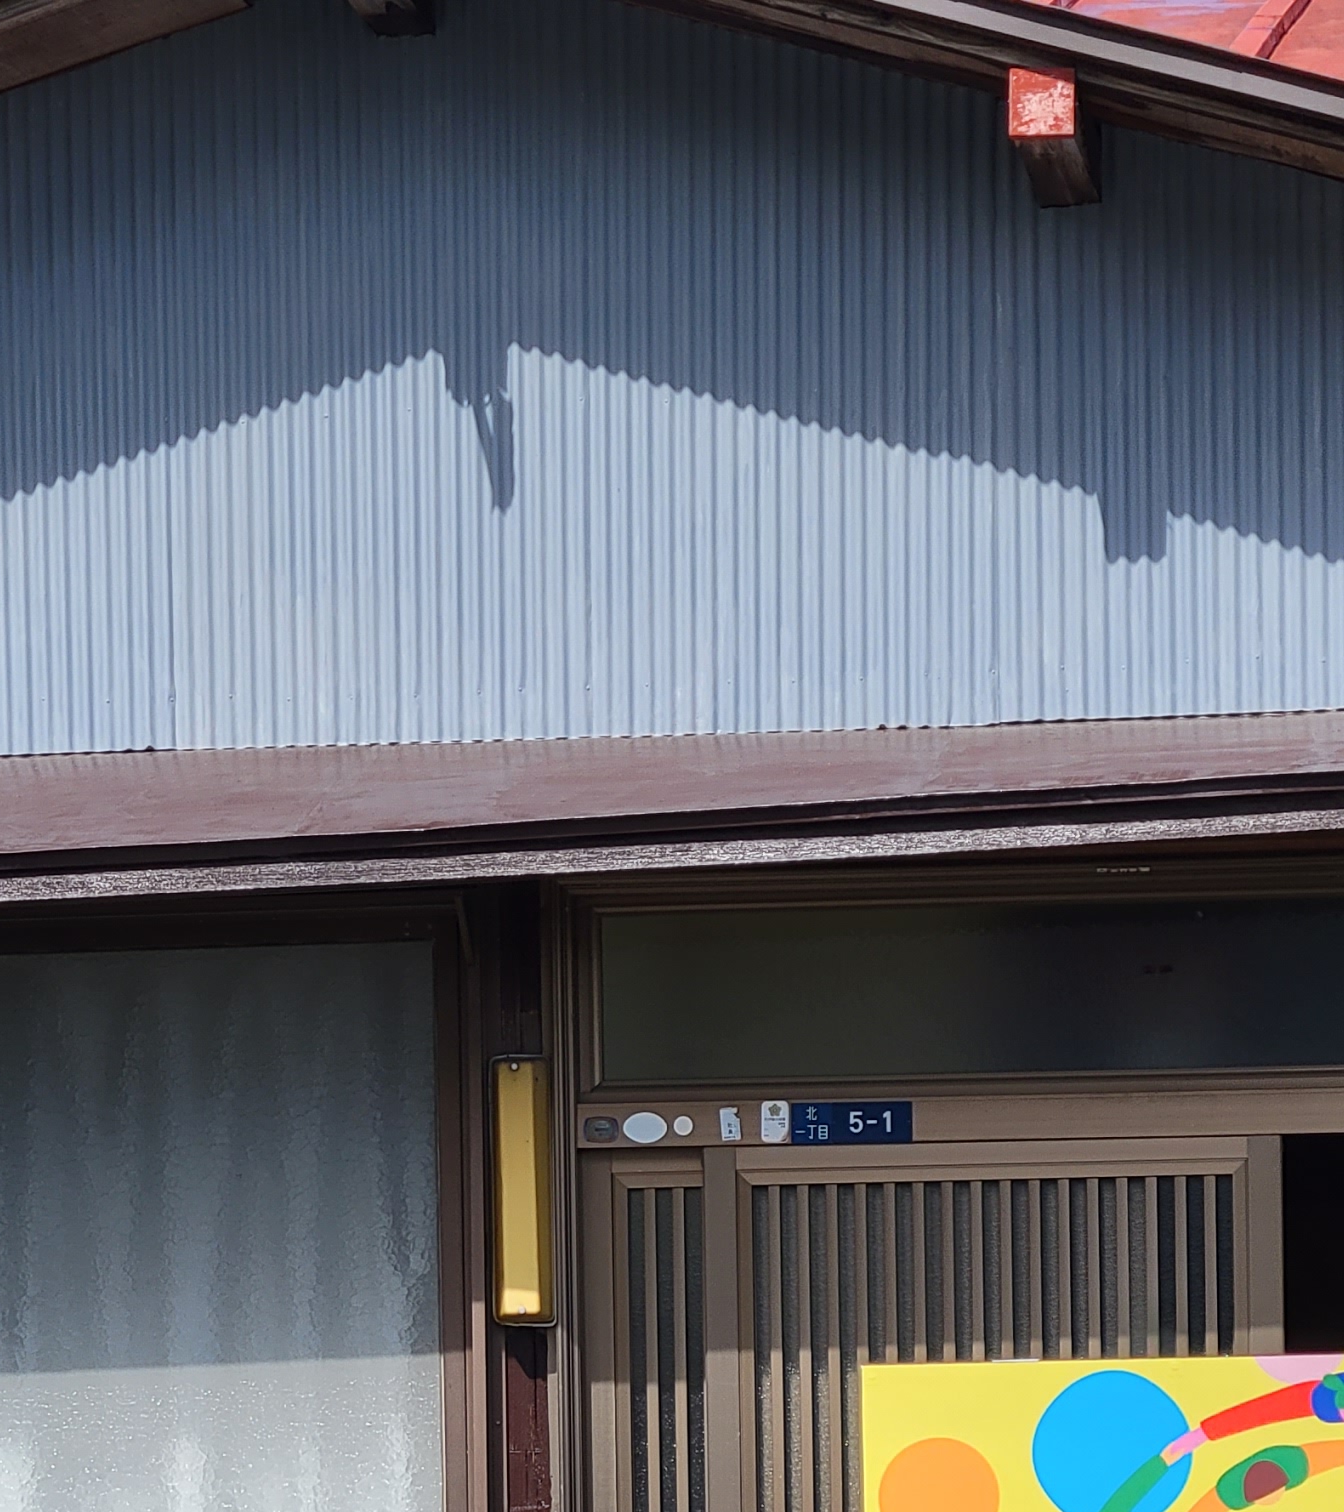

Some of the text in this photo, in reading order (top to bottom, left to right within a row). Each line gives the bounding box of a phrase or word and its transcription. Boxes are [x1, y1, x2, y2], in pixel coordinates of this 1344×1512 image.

[805, 1105, 818, 1121] 北
[848, 1110, 892, 1134] 5-1
[794, 1124, 829, 1140] 一丁目
